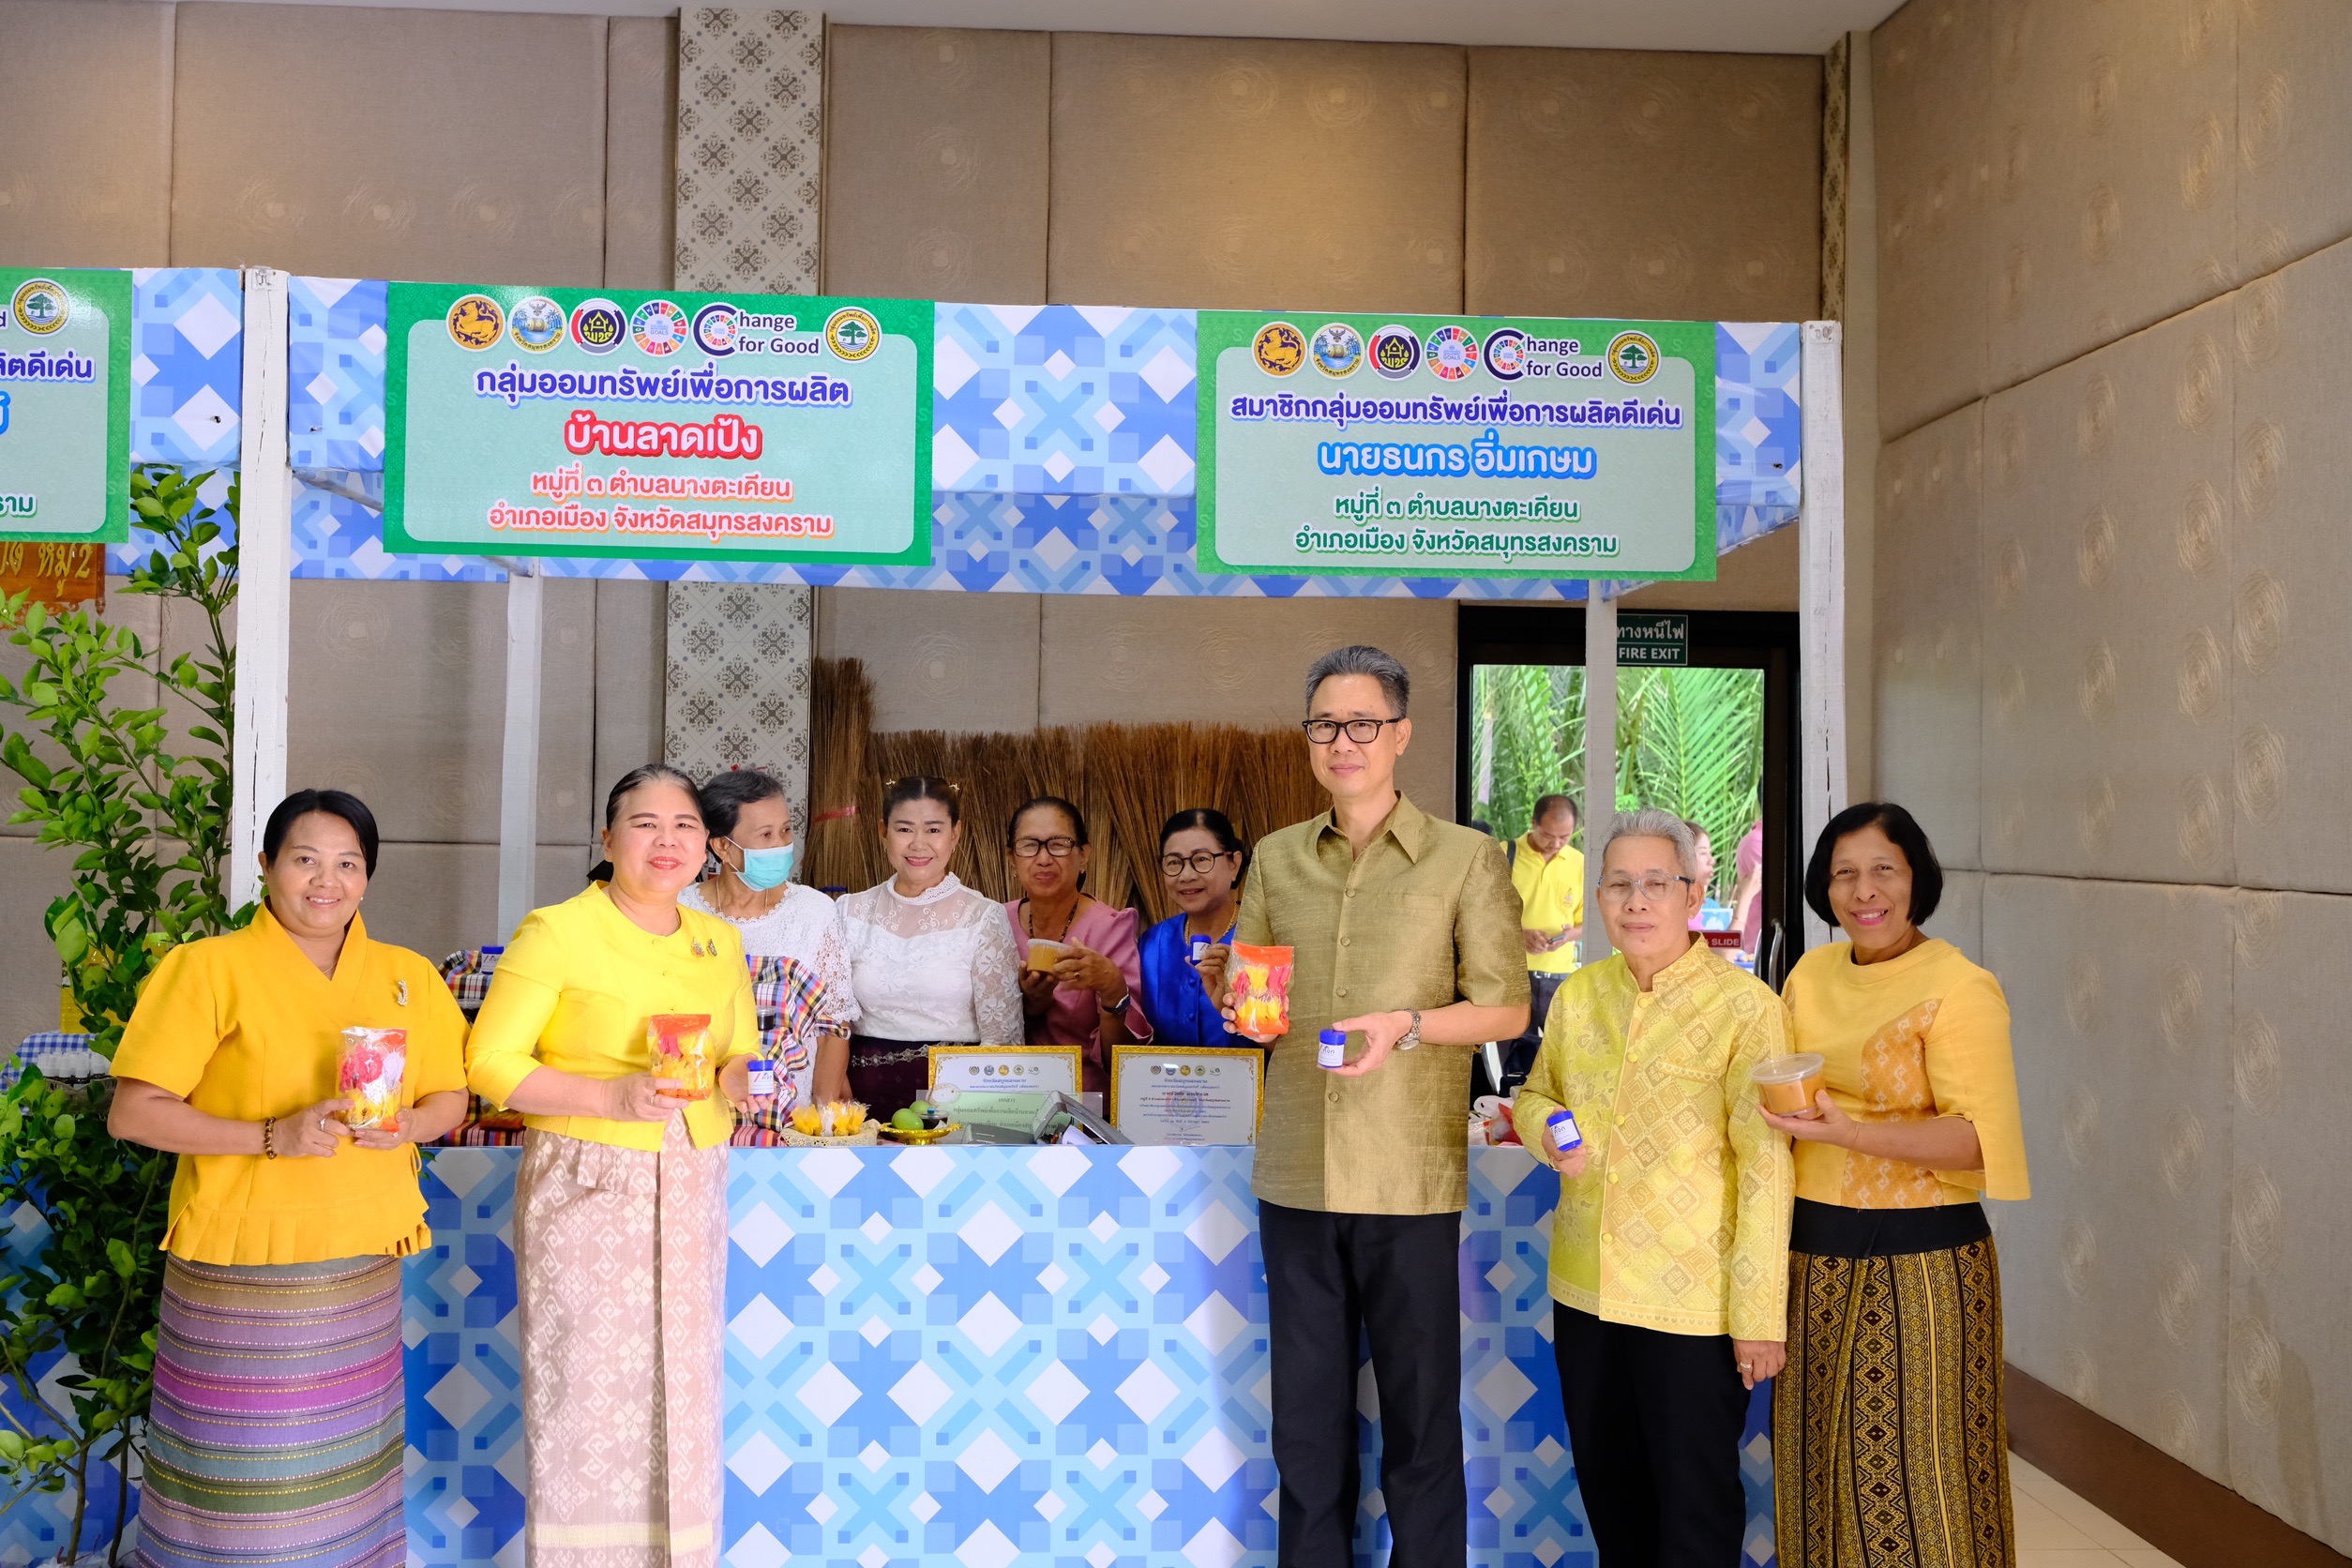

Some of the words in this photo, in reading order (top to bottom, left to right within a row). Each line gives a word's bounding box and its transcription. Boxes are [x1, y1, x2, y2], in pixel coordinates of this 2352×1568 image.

[738, 336, 765, 353] for
[770, 338, 820, 354] Good
[475, 362, 851, 404] กลุ่มออมทรัพย์เพื่อการผลิต
[1526, 359, 1551, 376] for
[1556, 362, 1602, 377] Good
[1230, 389, 1681, 427] สมาชิกกลุ่มออมทรัพย์เพื่อการผลิตดีเด่น
[566, 413, 760, 456] บ้านลาดเป้ง
[1319, 447, 1466, 474] นายธนกร
[1473, 431, 1592, 475] อิ่มเกษม
[532, 461, 580, 498] หมู่ที่
[586, 476, 603, 493] ๓
[610, 469, 792, 498] ตำบลนางตะเคียน
[489, 501, 606, 528] อำเภอเมือง
[613, 505, 831, 538] จังหวัดสมุทรสงคราม
[1334, 486, 1380, 523] หมู่ที่
[1386, 501, 1402, 516] ๓
[1408, 492, 1578, 518] ตำบลนางตะเคียน
[1295, 525, 1405, 550] อำเภอเมือง
[1412, 528, 1617, 559] จังหวัดสมุทรสงคราม
[1616, 619, 1684, 640] ทางหนีไฟ
[1619, 647, 1648, 659] FIRE
[1651, 648, 1681, 660] EXIT
[1711, 938, 1740, 946] SLIDE
